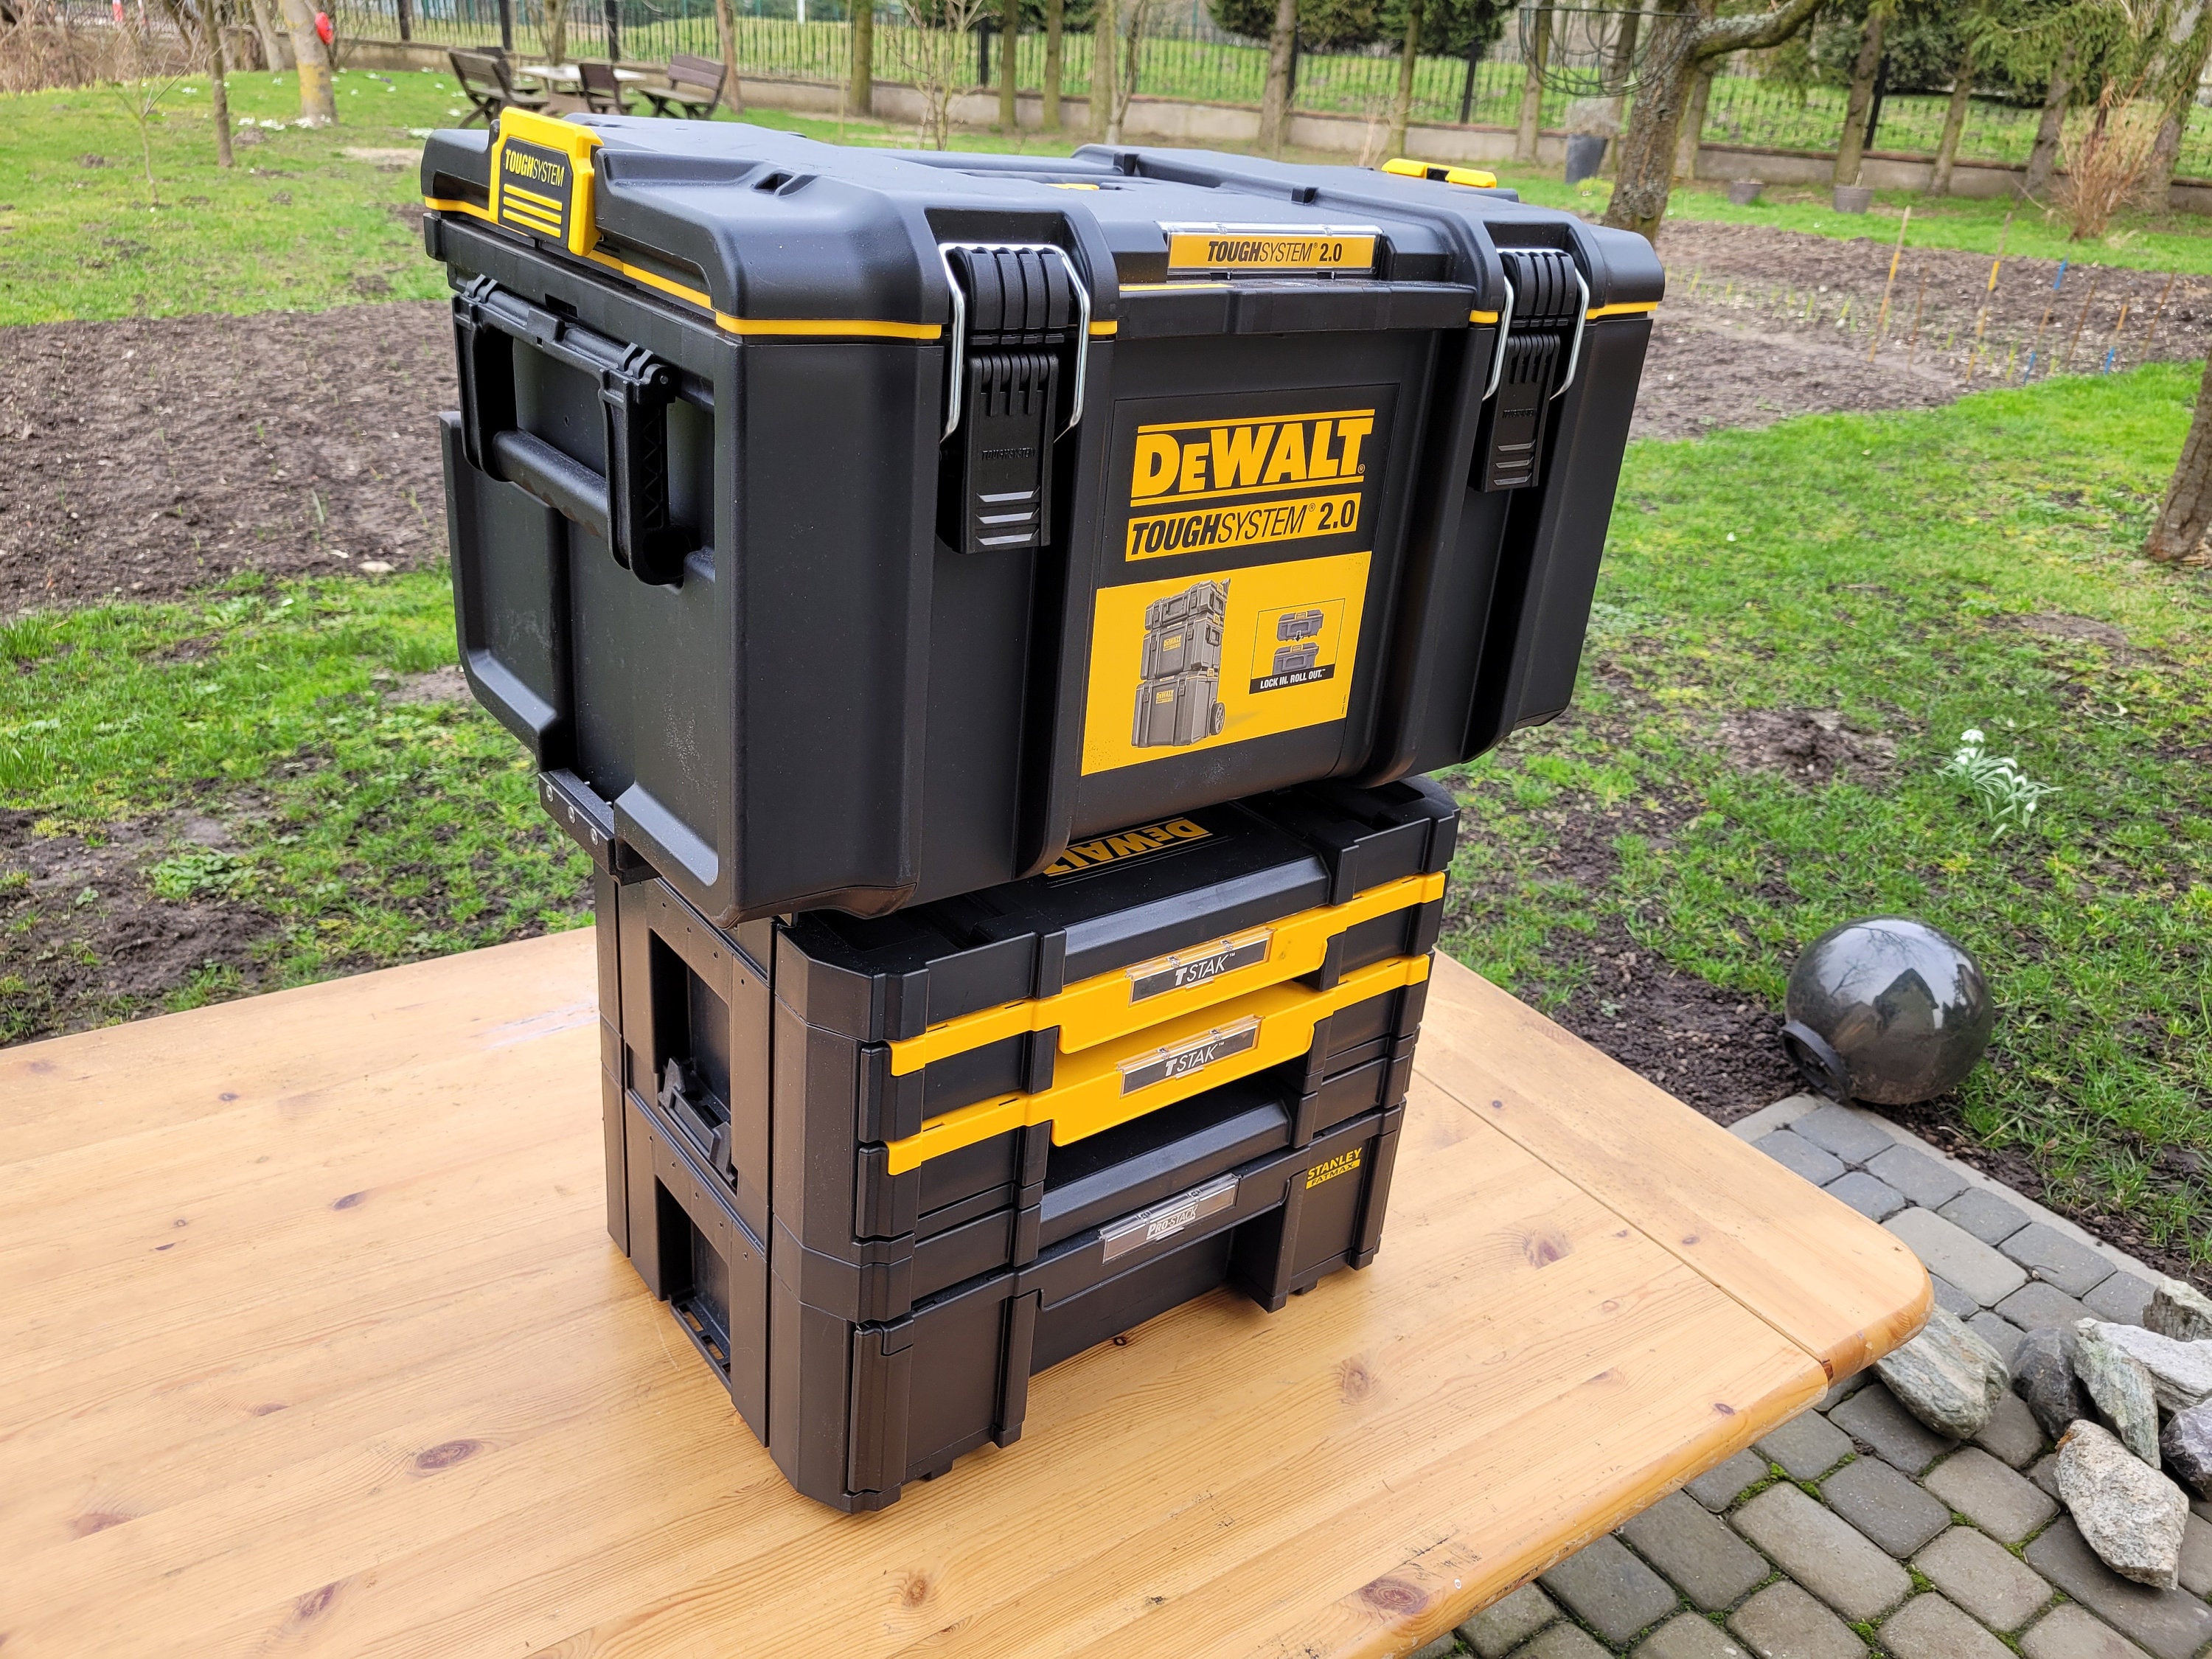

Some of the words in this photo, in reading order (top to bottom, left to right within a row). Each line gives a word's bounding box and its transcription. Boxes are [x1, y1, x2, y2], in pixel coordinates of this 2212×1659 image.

[504, 149, 565, 187] TOUGHSYSTEM
[1319, 243, 1342, 262] 2.0
[1318, 500, 1355, 531] 2.0
[1260, 678, 1278, 689] LOCK
[1279, 676, 1289, 686] IN.
[1290, 672, 1307, 684] ROLL
[1307, 1147, 1363, 1180] STANLEY
[1146, 1204, 1199, 1238] PRO-STACK
